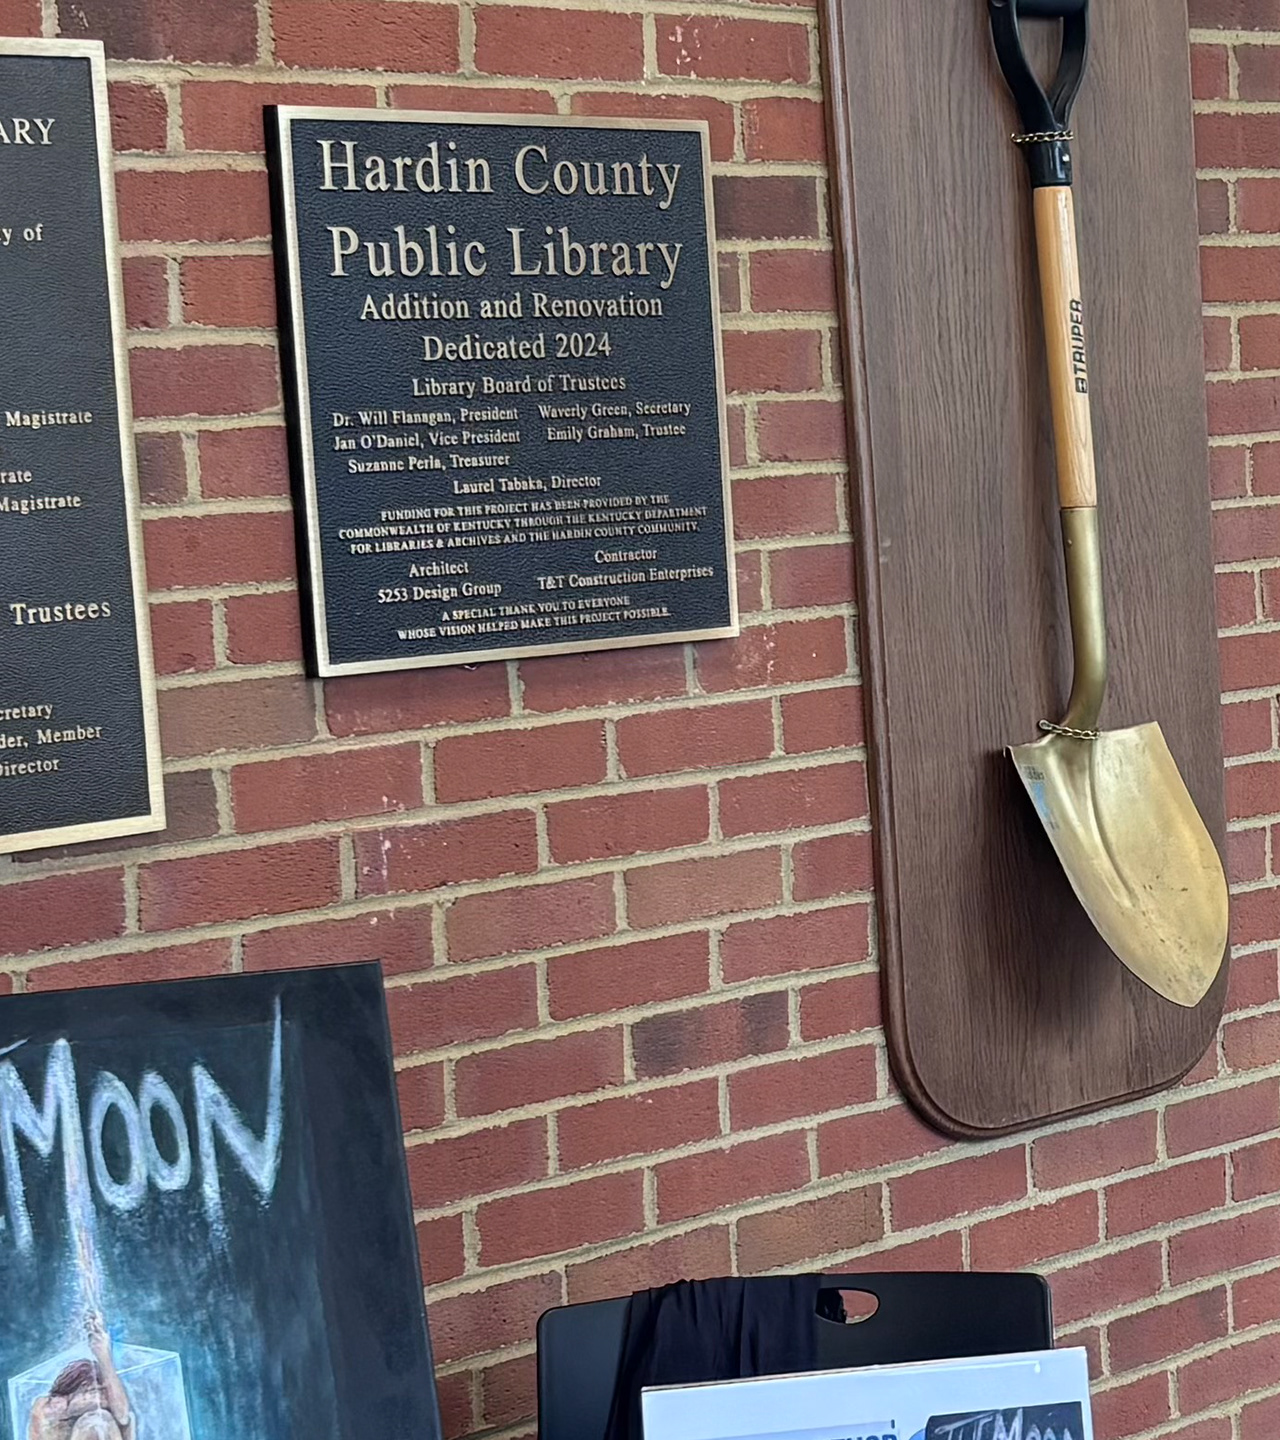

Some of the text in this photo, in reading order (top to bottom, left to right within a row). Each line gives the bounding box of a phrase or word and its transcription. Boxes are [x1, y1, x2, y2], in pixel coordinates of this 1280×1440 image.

[317, 139, 681, 209] Hardin County
[23, 222, 44, 241] of
[327, 226, 683, 289] Public Library
[361, 292, 662, 320] Addition and Renovation
[1070, 298, 1087, 374] TRUPER
[423, 332, 612, 362] Dedicated 2024
[413, 374, 625, 399] Library Board of Trustees
[333, 408, 518, 427] Dr. Will Flanagan, President
[538, 402, 691, 420] Waverly Green, Secretary
[334, 431, 520, 451] Jan O'Daniel, Vice President
[548, 424, 686, 442] Emily Graham, Trustee
[348, 454, 510, 473] Suzanne Perla, Treasurer
[453, 476, 601, 494] Laurel Tabaka, Director
[595, 550, 657, 564] Contractor
[409, 562, 469, 577] Architect
[538, 565, 714, 589] T&T Construction Enterprises
[378, 582, 501, 603] 5253 Design Group
[10, 601, 111, 626] Trustees
